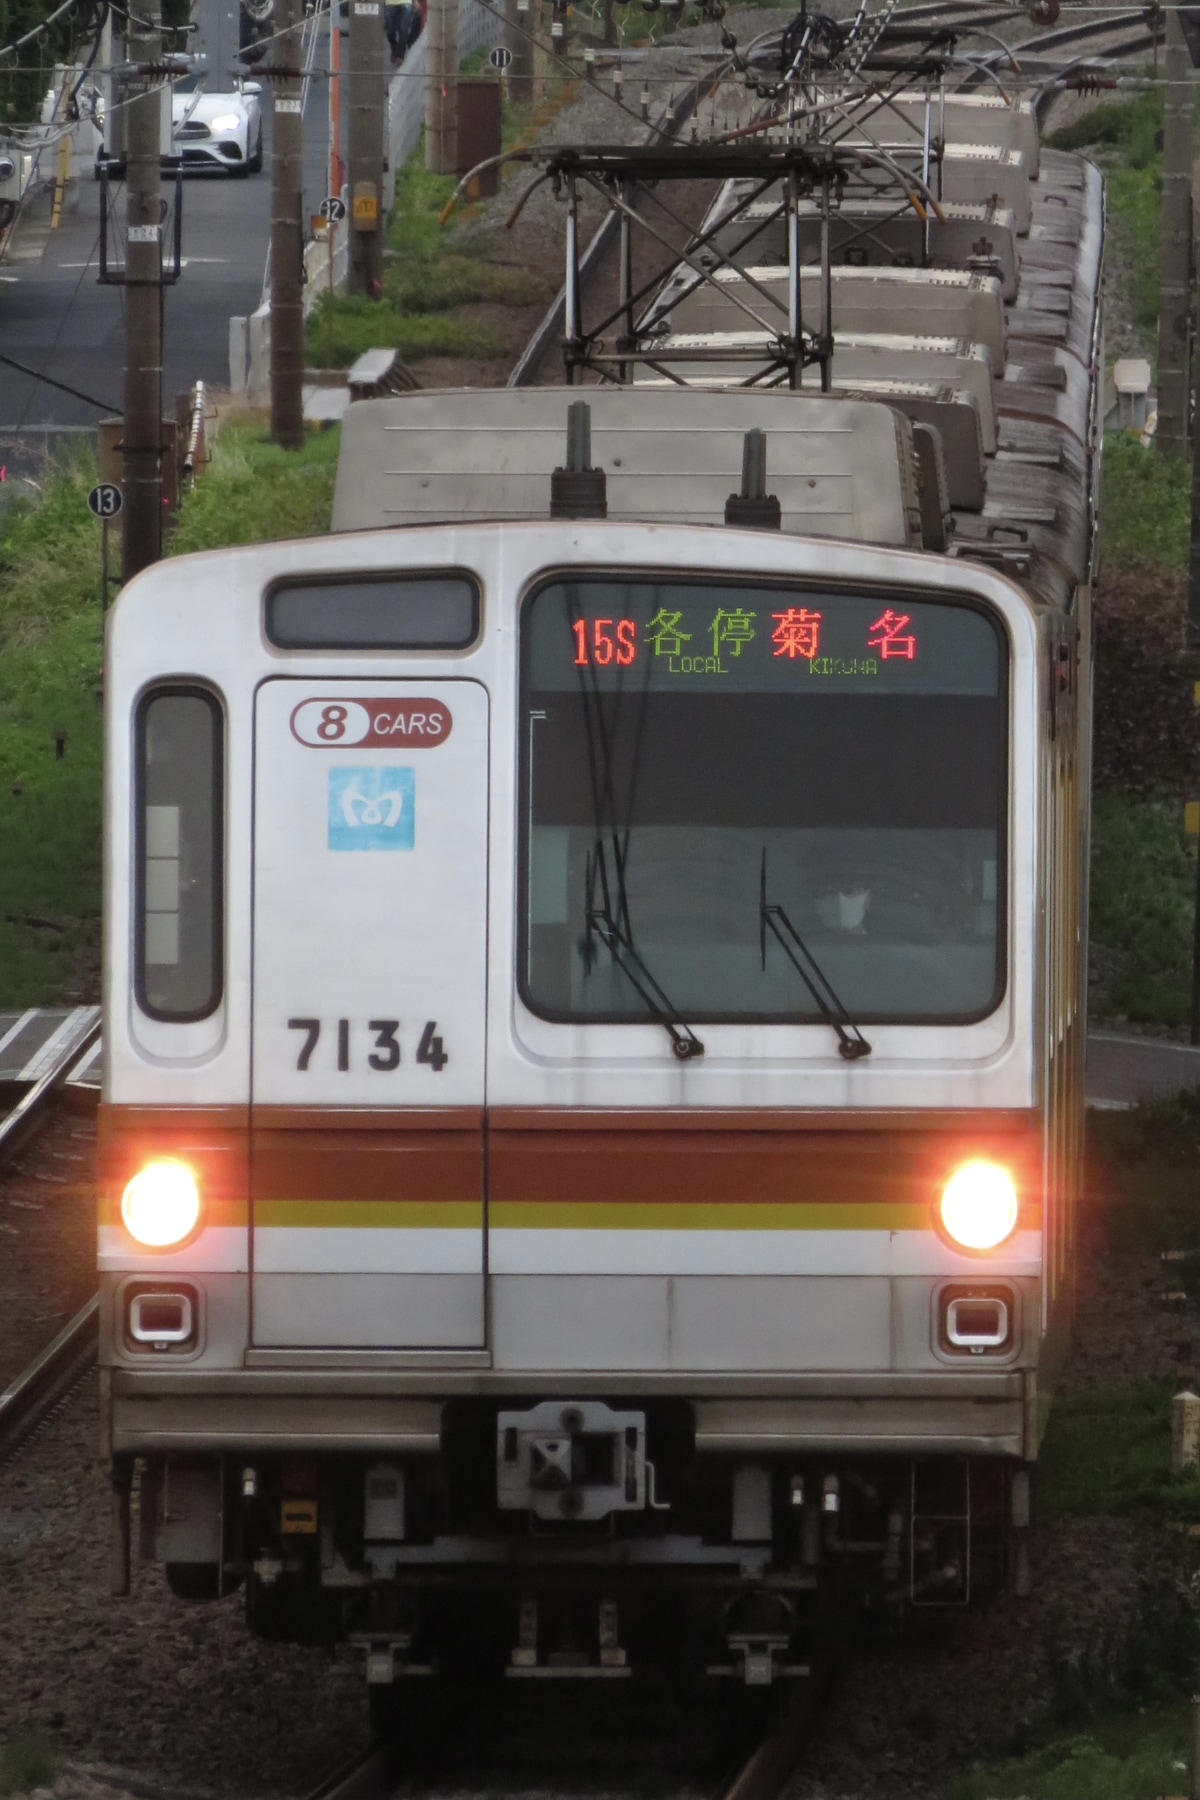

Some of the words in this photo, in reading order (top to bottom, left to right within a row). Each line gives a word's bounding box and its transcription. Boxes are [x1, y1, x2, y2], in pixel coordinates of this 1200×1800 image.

[495, 49, 507, 66] 11
[325, 200, 340, 221] 12
[96, 487, 115, 514] 13
[572, 618, 636, 667] 15S
[644, 607, 758, 657] 各停
[668, 656, 729, 674] LOCAL
[316, 705, 347, 741] 8
[372, 711, 444, 736] CARS
[287, 1017, 449, 1073] 7134
